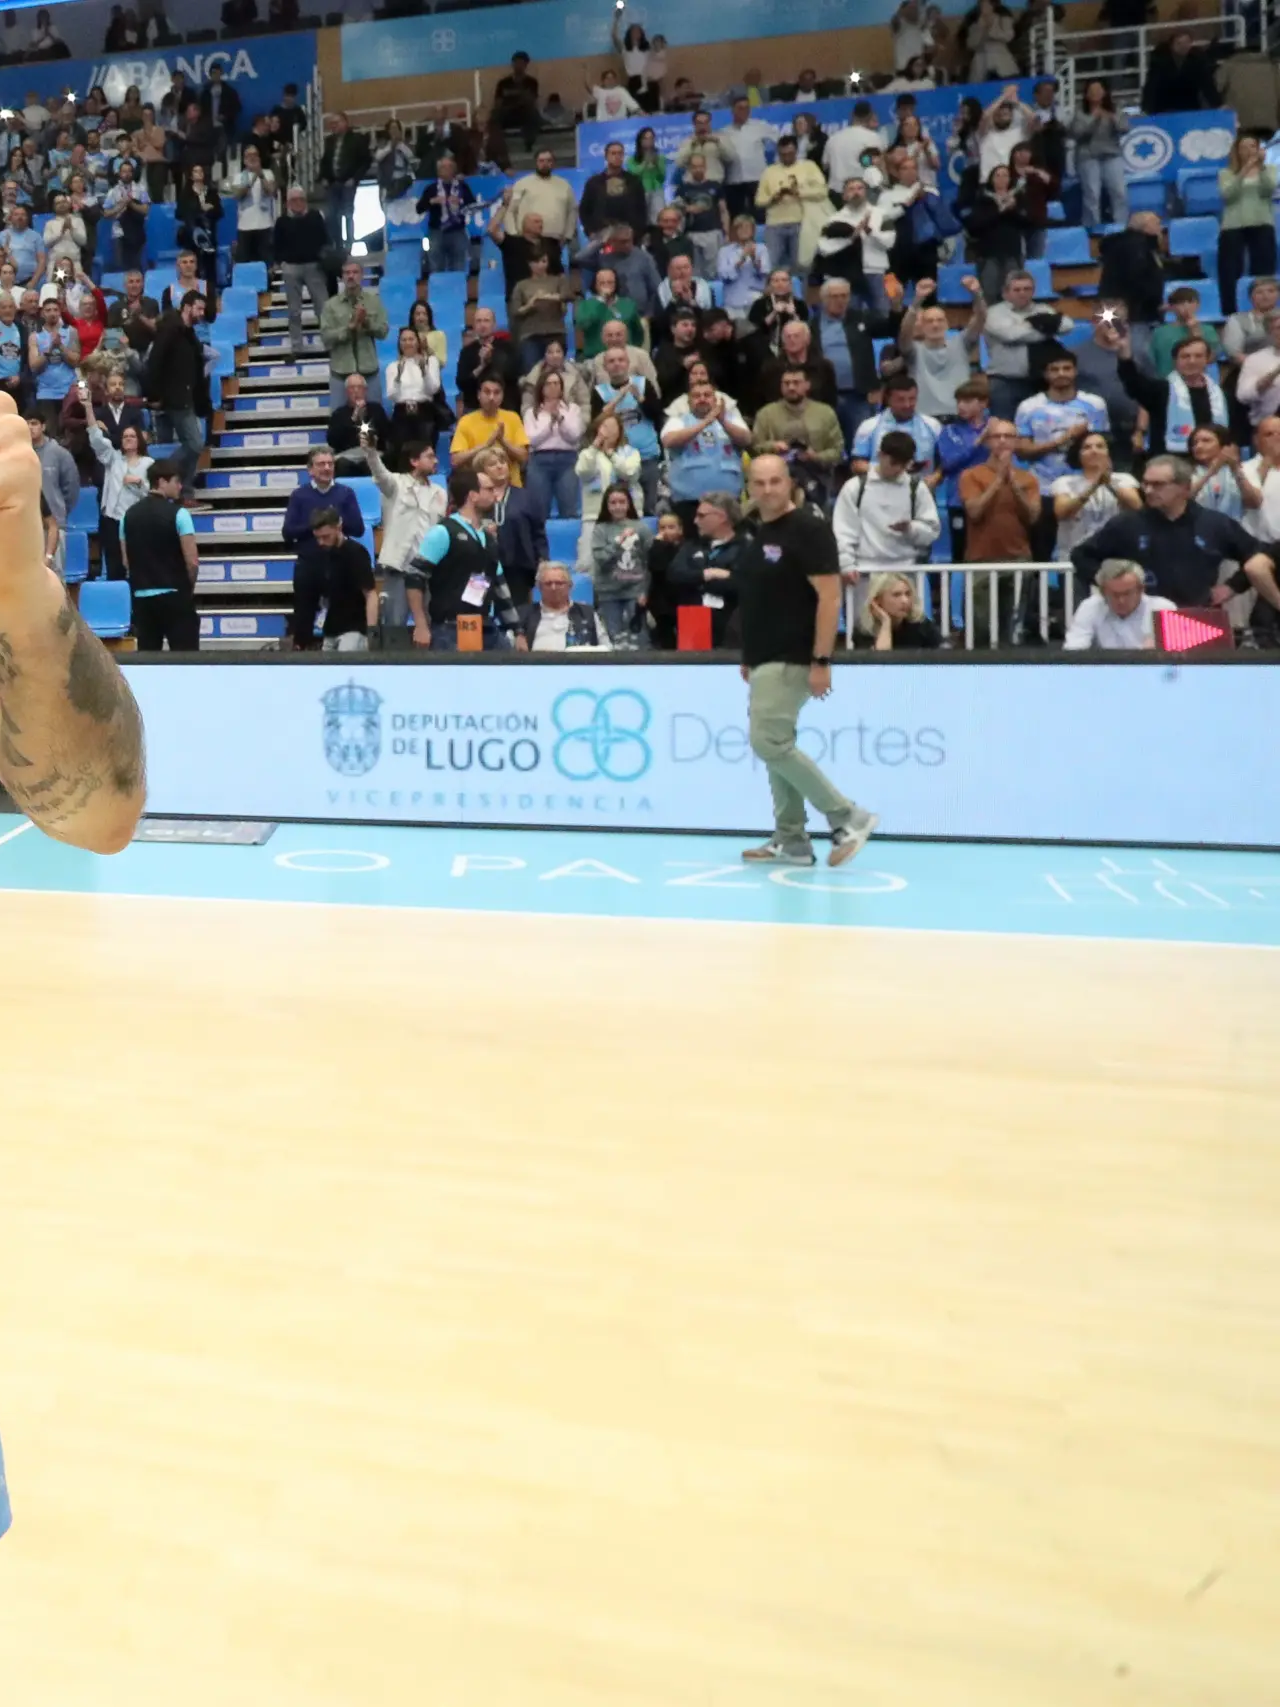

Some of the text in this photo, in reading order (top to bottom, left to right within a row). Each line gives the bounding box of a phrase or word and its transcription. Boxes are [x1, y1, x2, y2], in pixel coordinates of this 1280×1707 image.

[391, 711, 539, 732] DEPUTACIÓN
[671, 703, 947, 772] Deortes
[391, 737, 541, 772] DE LUGO
[326, 788, 655, 812] VICEPRESIDENCIA
